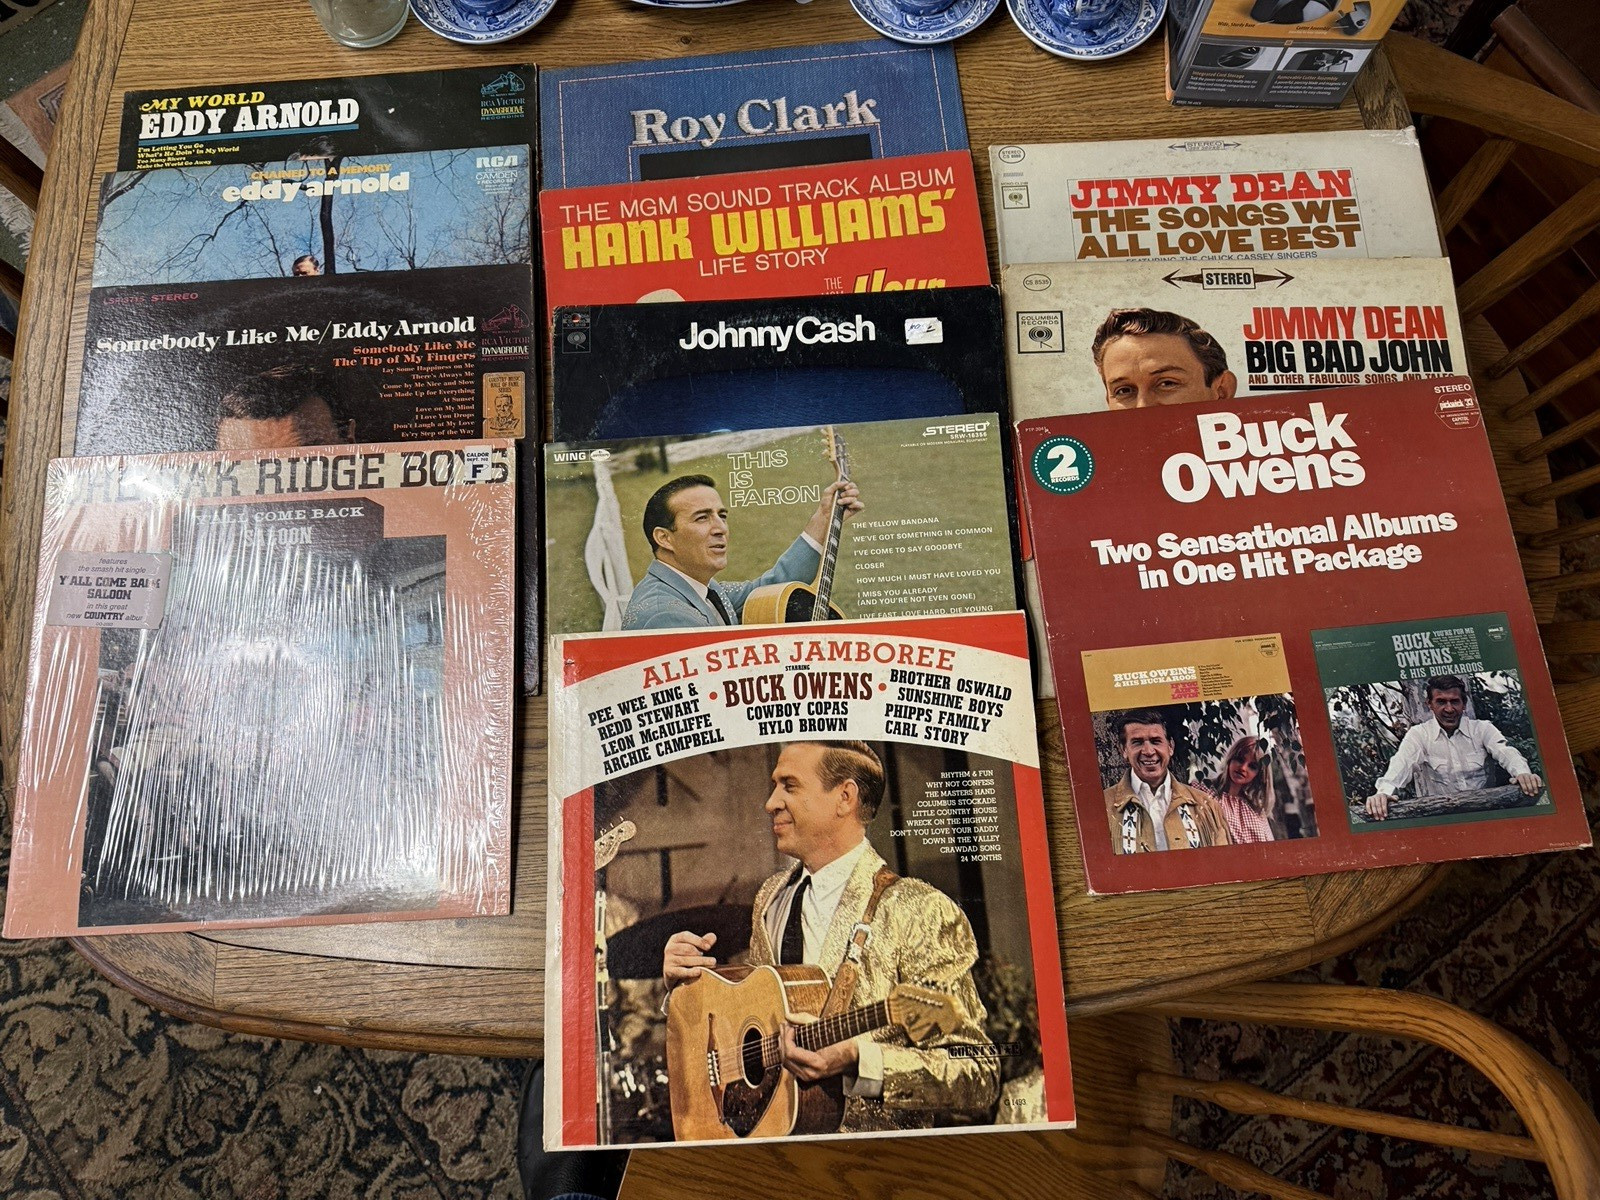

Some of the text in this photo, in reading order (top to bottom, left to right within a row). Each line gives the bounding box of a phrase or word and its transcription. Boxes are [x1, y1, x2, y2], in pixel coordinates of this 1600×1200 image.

[139, 91, 265, 112] MY WORLD
[139, 98, 359, 140] EDDY ARNOLD
[629, 89, 882, 148] Roy Clark
[152, 145, 178, 153] Letting
[251, 164, 392, 180] CHAINED TO A MEMORY
[476, 155, 518, 169] RCA
[475, 171, 518, 180] CAMDEN
[222, 171, 410, 202] eddy arnold
[559, 166, 956, 226] THE MGM SOUND TRACK ALBUM
[1070, 169, 1353, 210] JIMMY DEAN
[1072, 198, 1361, 234] THE SONGS WE
[561, 187, 957, 271] HANK WILLIAMS'
[1076, 224, 1362, 260] ALL LOVE BEST
[699, 246, 831, 278] LIFE STORY
[1236, 252, 1275, 260] CASSEY
[1276, 250, 1318, 260] SINGERS
[1205, 271, 1252, 287] STEREO
[151, 292, 199, 303] STEREO
[678, 314, 877, 352] Johnny Cash
[1242, 305, 1449, 340] JIMMY DEAN
[95, 331, 220, 354] Somebody
[225, 328, 278, 347] Like
[393, 315, 477, 337] Arnold
[353, 339, 476, 356] Somebody Like Me
[481, 345, 530, 355] DYNAGROOVE
[1244, 339, 1454, 374] BIG BAD JOHN
[332, 351, 476, 367] The Tip of My Fingers
[1248, 373, 1422, 385] AND OTHER FABULOUS SONGS AND
[1433, 383, 1472, 394] STEREO
[923, 421, 988, 437] STEREO
[1196, 401, 1358, 463] Buck
[553, 452, 587, 462] WING
[726, 448, 789, 471] THIS
[1046, 444, 1080, 480] 2
[255, 452, 385, 495] RIDGE
[728, 470, 754, 490] IS
[1160, 449, 1367, 504] Owens
[729, 484, 821, 508] FARON
[254, 509, 307, 523] COME
[311, 506, 365, 520] BACK
[852, 517, 940, 530] THE YELLOW BANDANA
[852, 534, 878, 543] WE'VE
[878, 533, 896, 542] GOT
[896, 530, 943, 540] SOMETHING
[954, 526, 993, 536] COMMON
[1090, 511, 1459, 566] Two Sensational Albums
[91, 566, 114, 574] smash
[114, 566, 126, 574] hit
[125, 567, 147, 575] single
[98, 557, 128, 565] features
[855, 562, 886, 571] CLOSER
[1137, 542, 1423, 590] in One Hit Package
[86, 588, 132, 600] SALOON
[94, 602, 109, 610] this
[108, 603, 129, 611] great
[1392, 631, 1435, 652] BUCK
[642, 640, 957, 690] ALL STAR JAMBOREE
[1395, 647, 1454, 669] OWENS
[1112, 665, 1196, 682] BUCK OWENS
[722, 671, 874, 708] BUCK OWENS
[889, 668, 1013, 702] BROTHER OSWALD
[587, 682, 700, 728] PEE WEE KING &
[746, 701, 850, 721] COWBOY COPAS
[897, 687, 1005, 719] SUNSHINE BOYS
[596, 698, 701, 742] REDD STEWART
[758, 717, 849, 737] HYLO BROWN
[600, 712, 713, 759] LEON McAULIFFE
[926, 779, 995, 789] WHY NOT CONFESS
[917, 797, 997, 808] COLUMBUS STOCKADE
[960, 854, 1003, 863] 24 MONTHS
